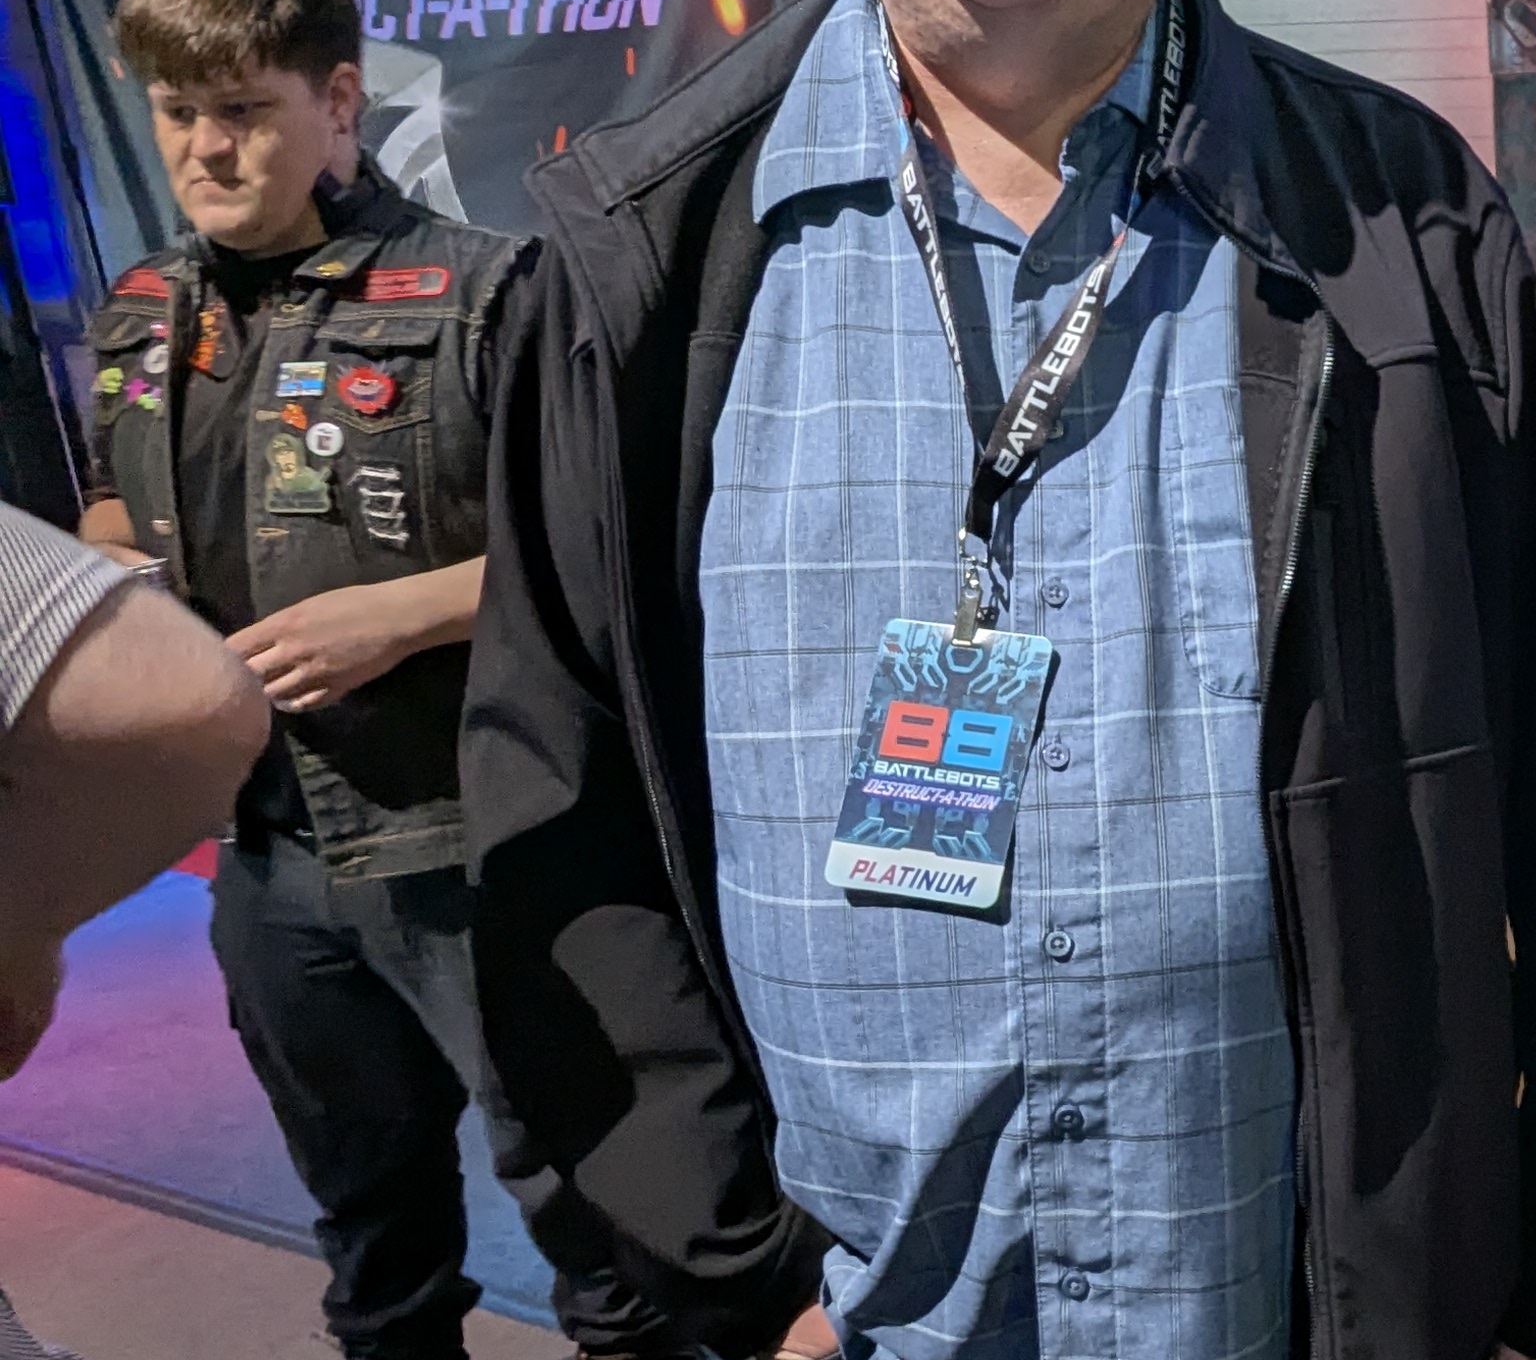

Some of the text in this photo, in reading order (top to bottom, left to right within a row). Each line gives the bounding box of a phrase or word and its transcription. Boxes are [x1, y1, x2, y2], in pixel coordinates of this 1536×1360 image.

[992, 262, 1107, 478] BATTLEBOTS
[873, 760, 1001, 790] BATTLEBOTS
[862, 778, 1002, 811] DESTRUCT-A-THON
[848, 859, 978, 898] PLATINUM
